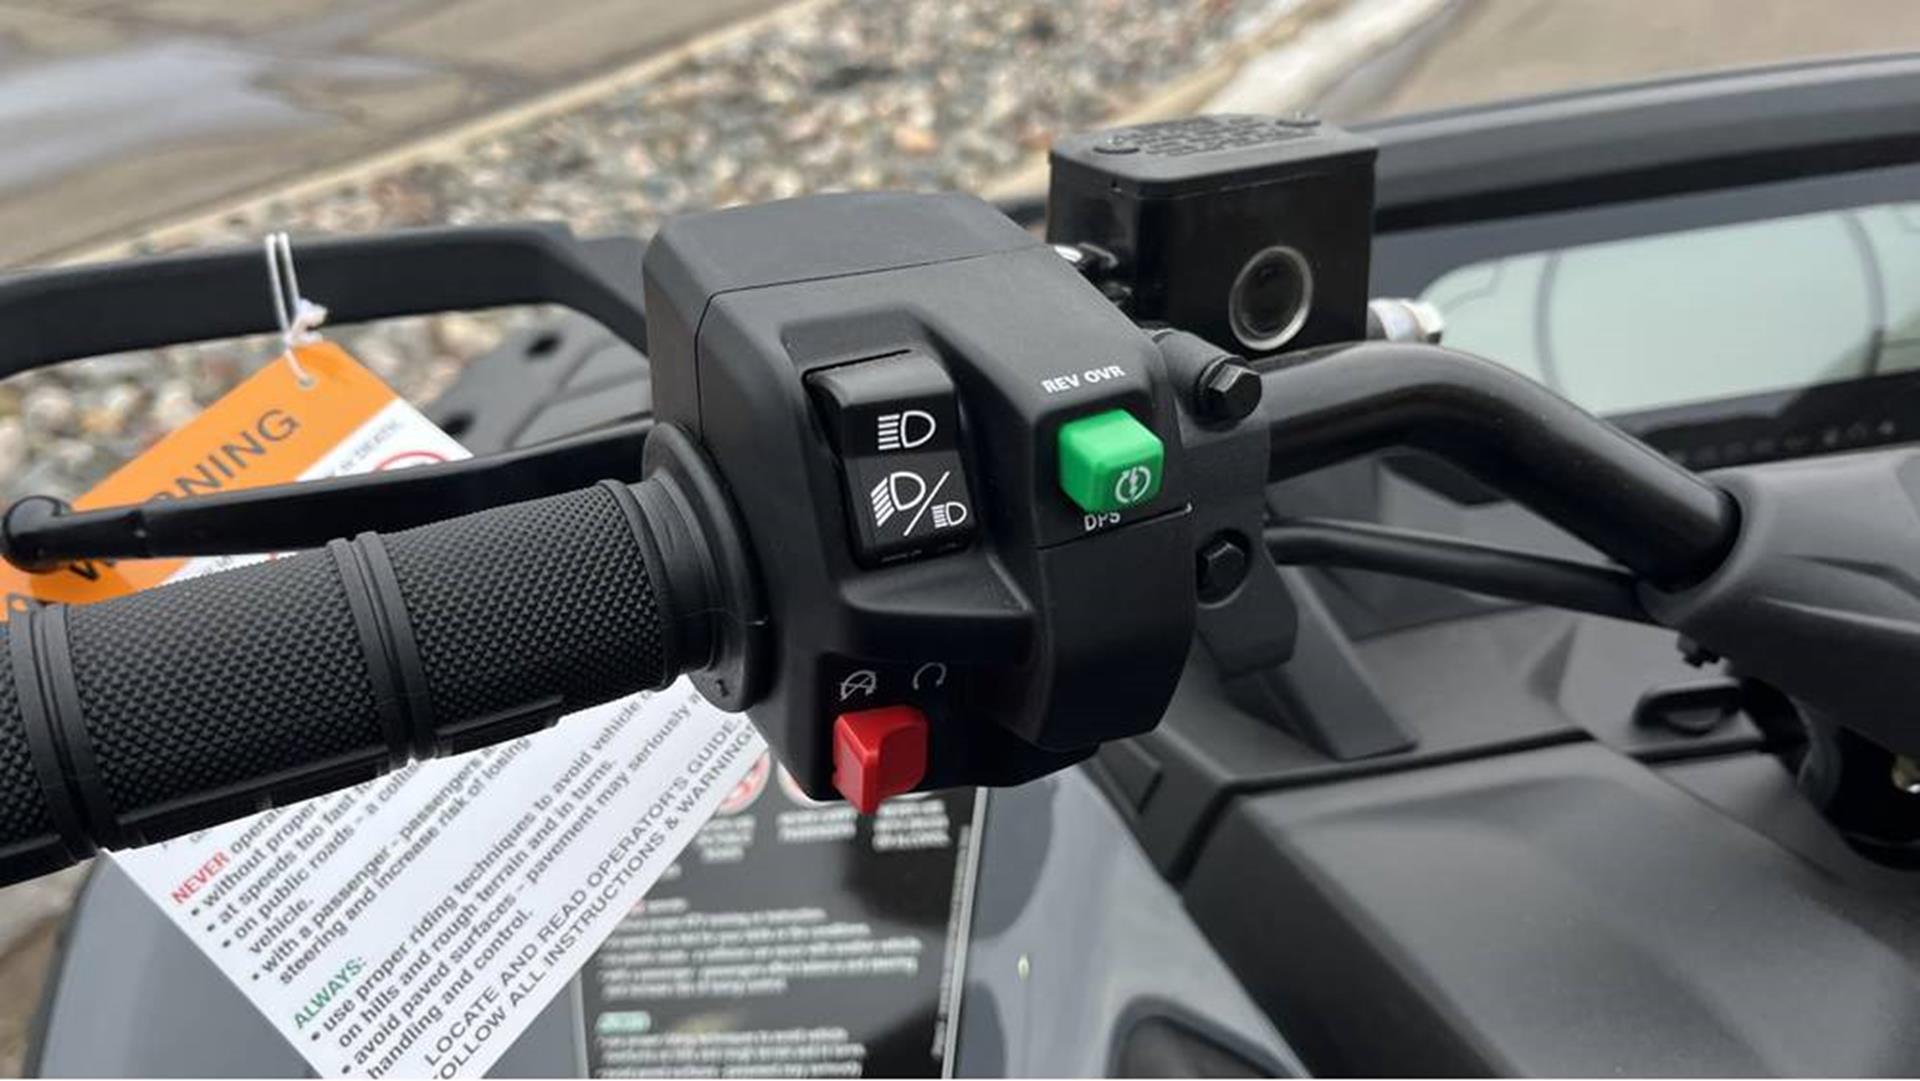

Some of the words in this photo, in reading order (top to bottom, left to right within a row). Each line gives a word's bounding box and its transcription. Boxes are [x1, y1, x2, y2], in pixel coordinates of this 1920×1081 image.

[1042, 374, 1081, 394] REV
[1084, 365, 1126, 384] OVR
[171, 852, 230, 904] NEVER
[201, 849, 267, 908] without
[265, 801, 317, 854] proper
[218, 902, 240, 924] at
[238, 851, 297, 906] speeds
[294, 824, 325, 852] too
[322, 793, 356, 826] fast
[234, 916, 259, 940] on
[257, 868, 309, 921] public
[308, 825, 355, 870] roads
[364, 802, 380, 816] a
[377, 762, 423, 803] colli
[248, 899, 314, 954] vehicle.
[261, 938, 300, 973] with
[298, 925, 313, 940] a
[311, 846, 390, 930] passenger
[398, 758, 482, 843] passengers
[279, 919, 349, 985] steering
[345, 885, 378, 921] and
[372, 826, 440, 890] increase
[437, 796, 470, 827] risk
[467, 777, 486, 798] of
[322, 999, 356, 1032] use
[355, 941, 409, 1002] proper
[409, 895, 459, 945] riding
[453, 812, 537, 895] techniques
[533, 794, 553, 811] to
[552, 751, 593, 794] avoid
[589, 700, 642, 752] vehicle
[338, 1023, 363, 1048] on
[359, 985, 400, 1024] hills
[399, 949, 432, 986] and
[431, 903, 479, 953] rough
[475, 850, 529, 903] terrain
[527, 816, 559, 851] and
[554, 801, 575, 820] in
[353, 1013, 401, 1065] avoid
[400, 960, 451, 1019] paved
[449, 894, 517, 964] surfaces
[525, 805, 599, 885] pavement
[595, 771, 630, 807] may
[627, 705, 692, 772] seriously
[423, 985, 500, 1067] LOCATE
[500, 943, 538, 987] AND
[536, 889, 587, 943] READ
[586, 776, 689, 888] OPERATOR'S
[294, 957, 367, 1030] ALWAYS:
[366, 1005, 444, 1079] handling
[441, 968, 475, 1005] and
[473, 909, 534, 971] control.
[433, 1005, 506, 1079] OLLOW
[509, 971, 546, 1008] ALL
[543, 831, 666, 967] INSTRUCTIONS
[664, 816, 680, 831] &
